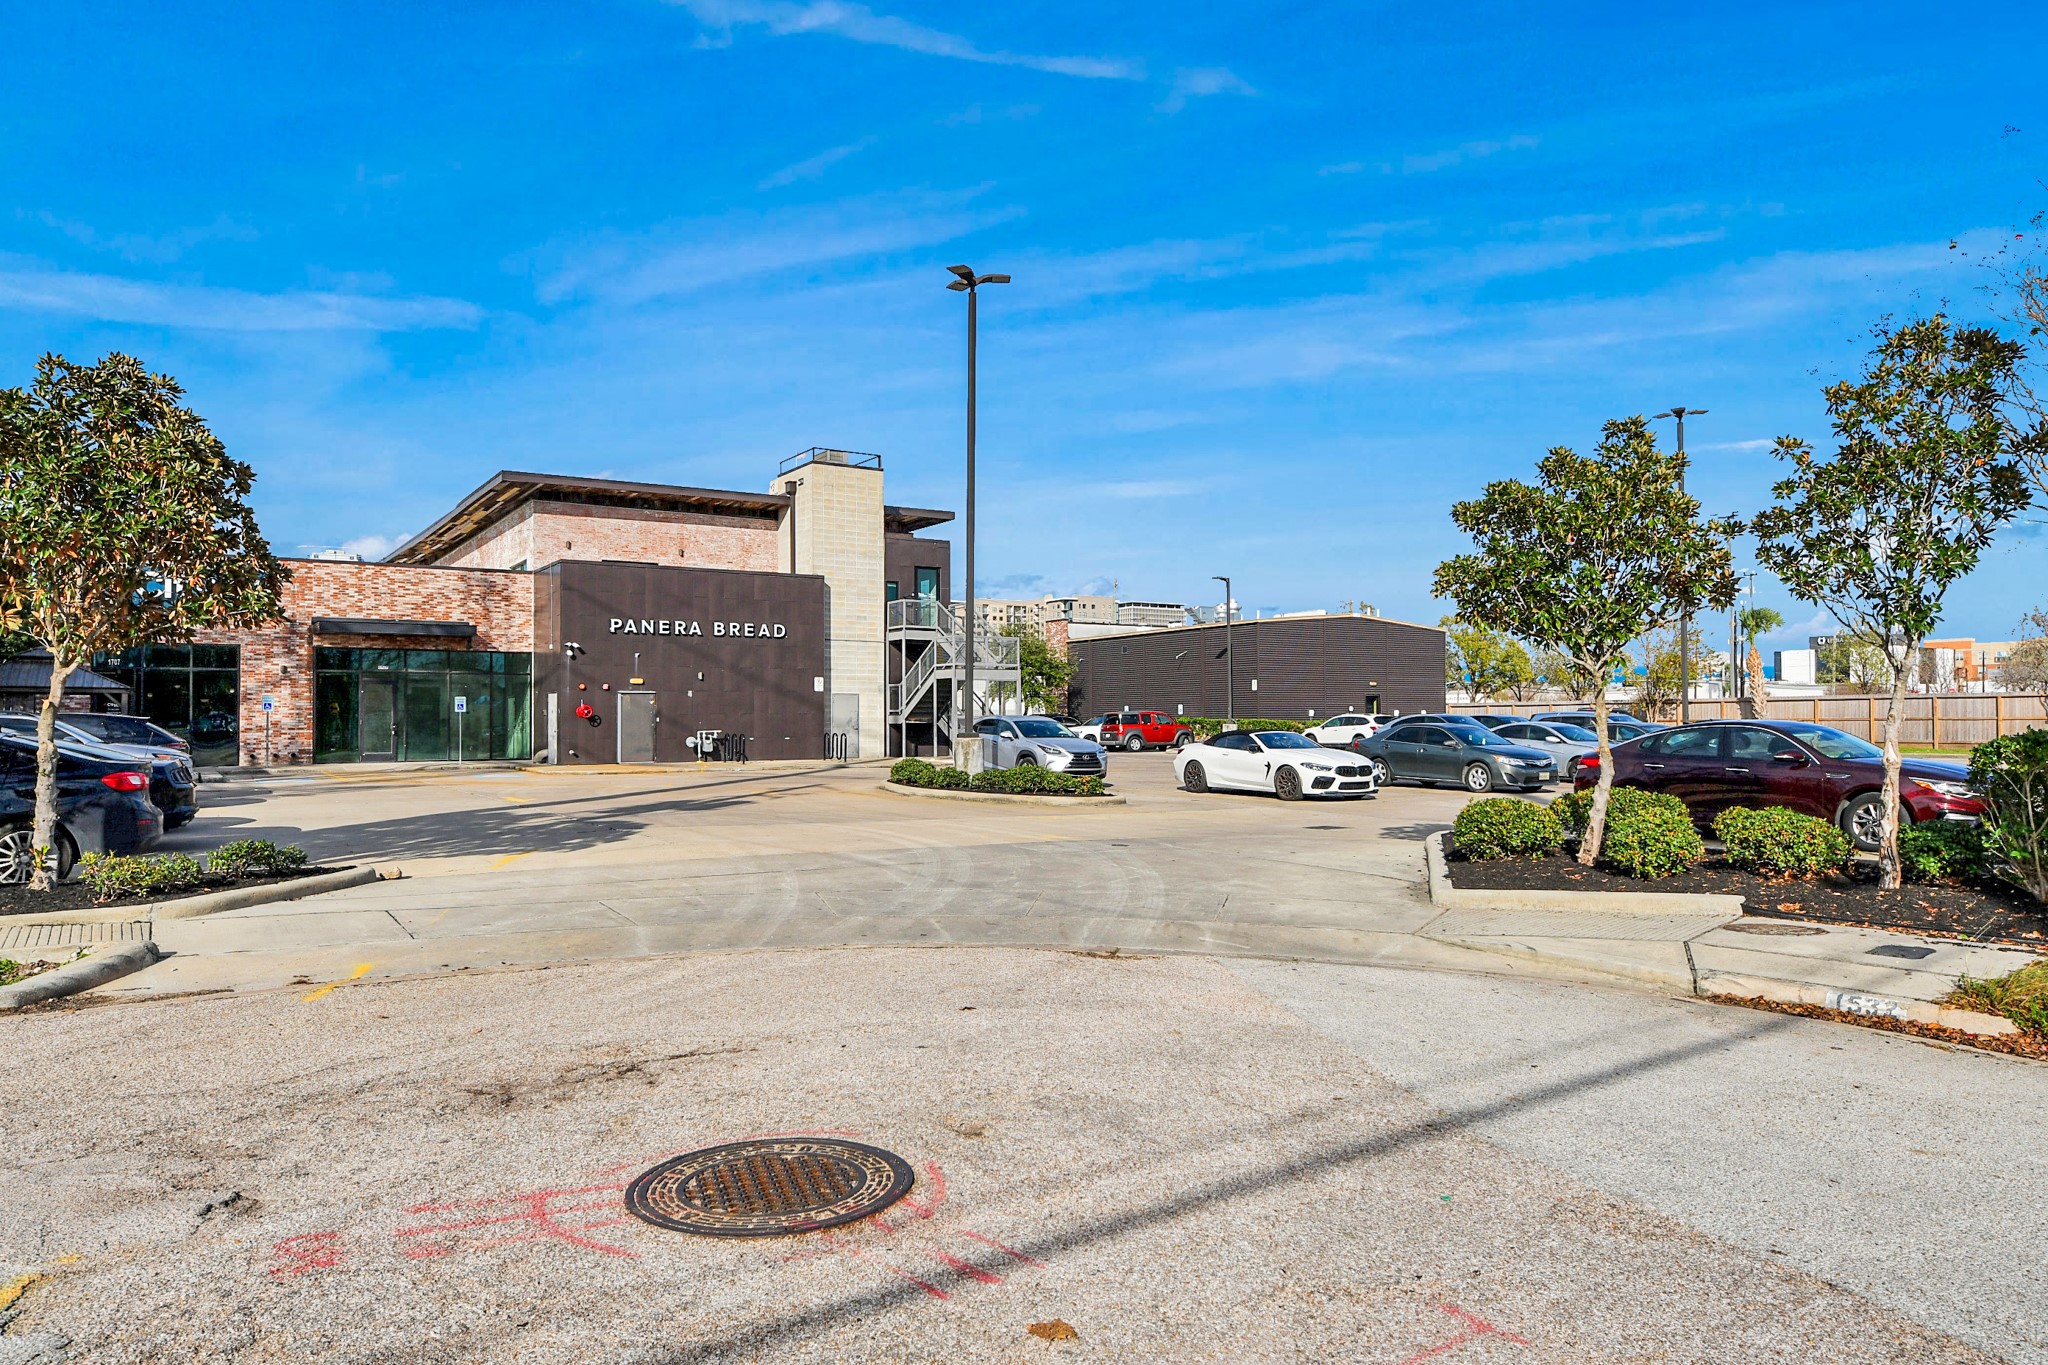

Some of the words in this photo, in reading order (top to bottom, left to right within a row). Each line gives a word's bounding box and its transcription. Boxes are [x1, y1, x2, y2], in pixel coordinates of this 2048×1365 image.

[610, 618, 703, 636] PANERA
[713, 621, 786, 639] BREAD
[108, 658, 121, 666] 1707
